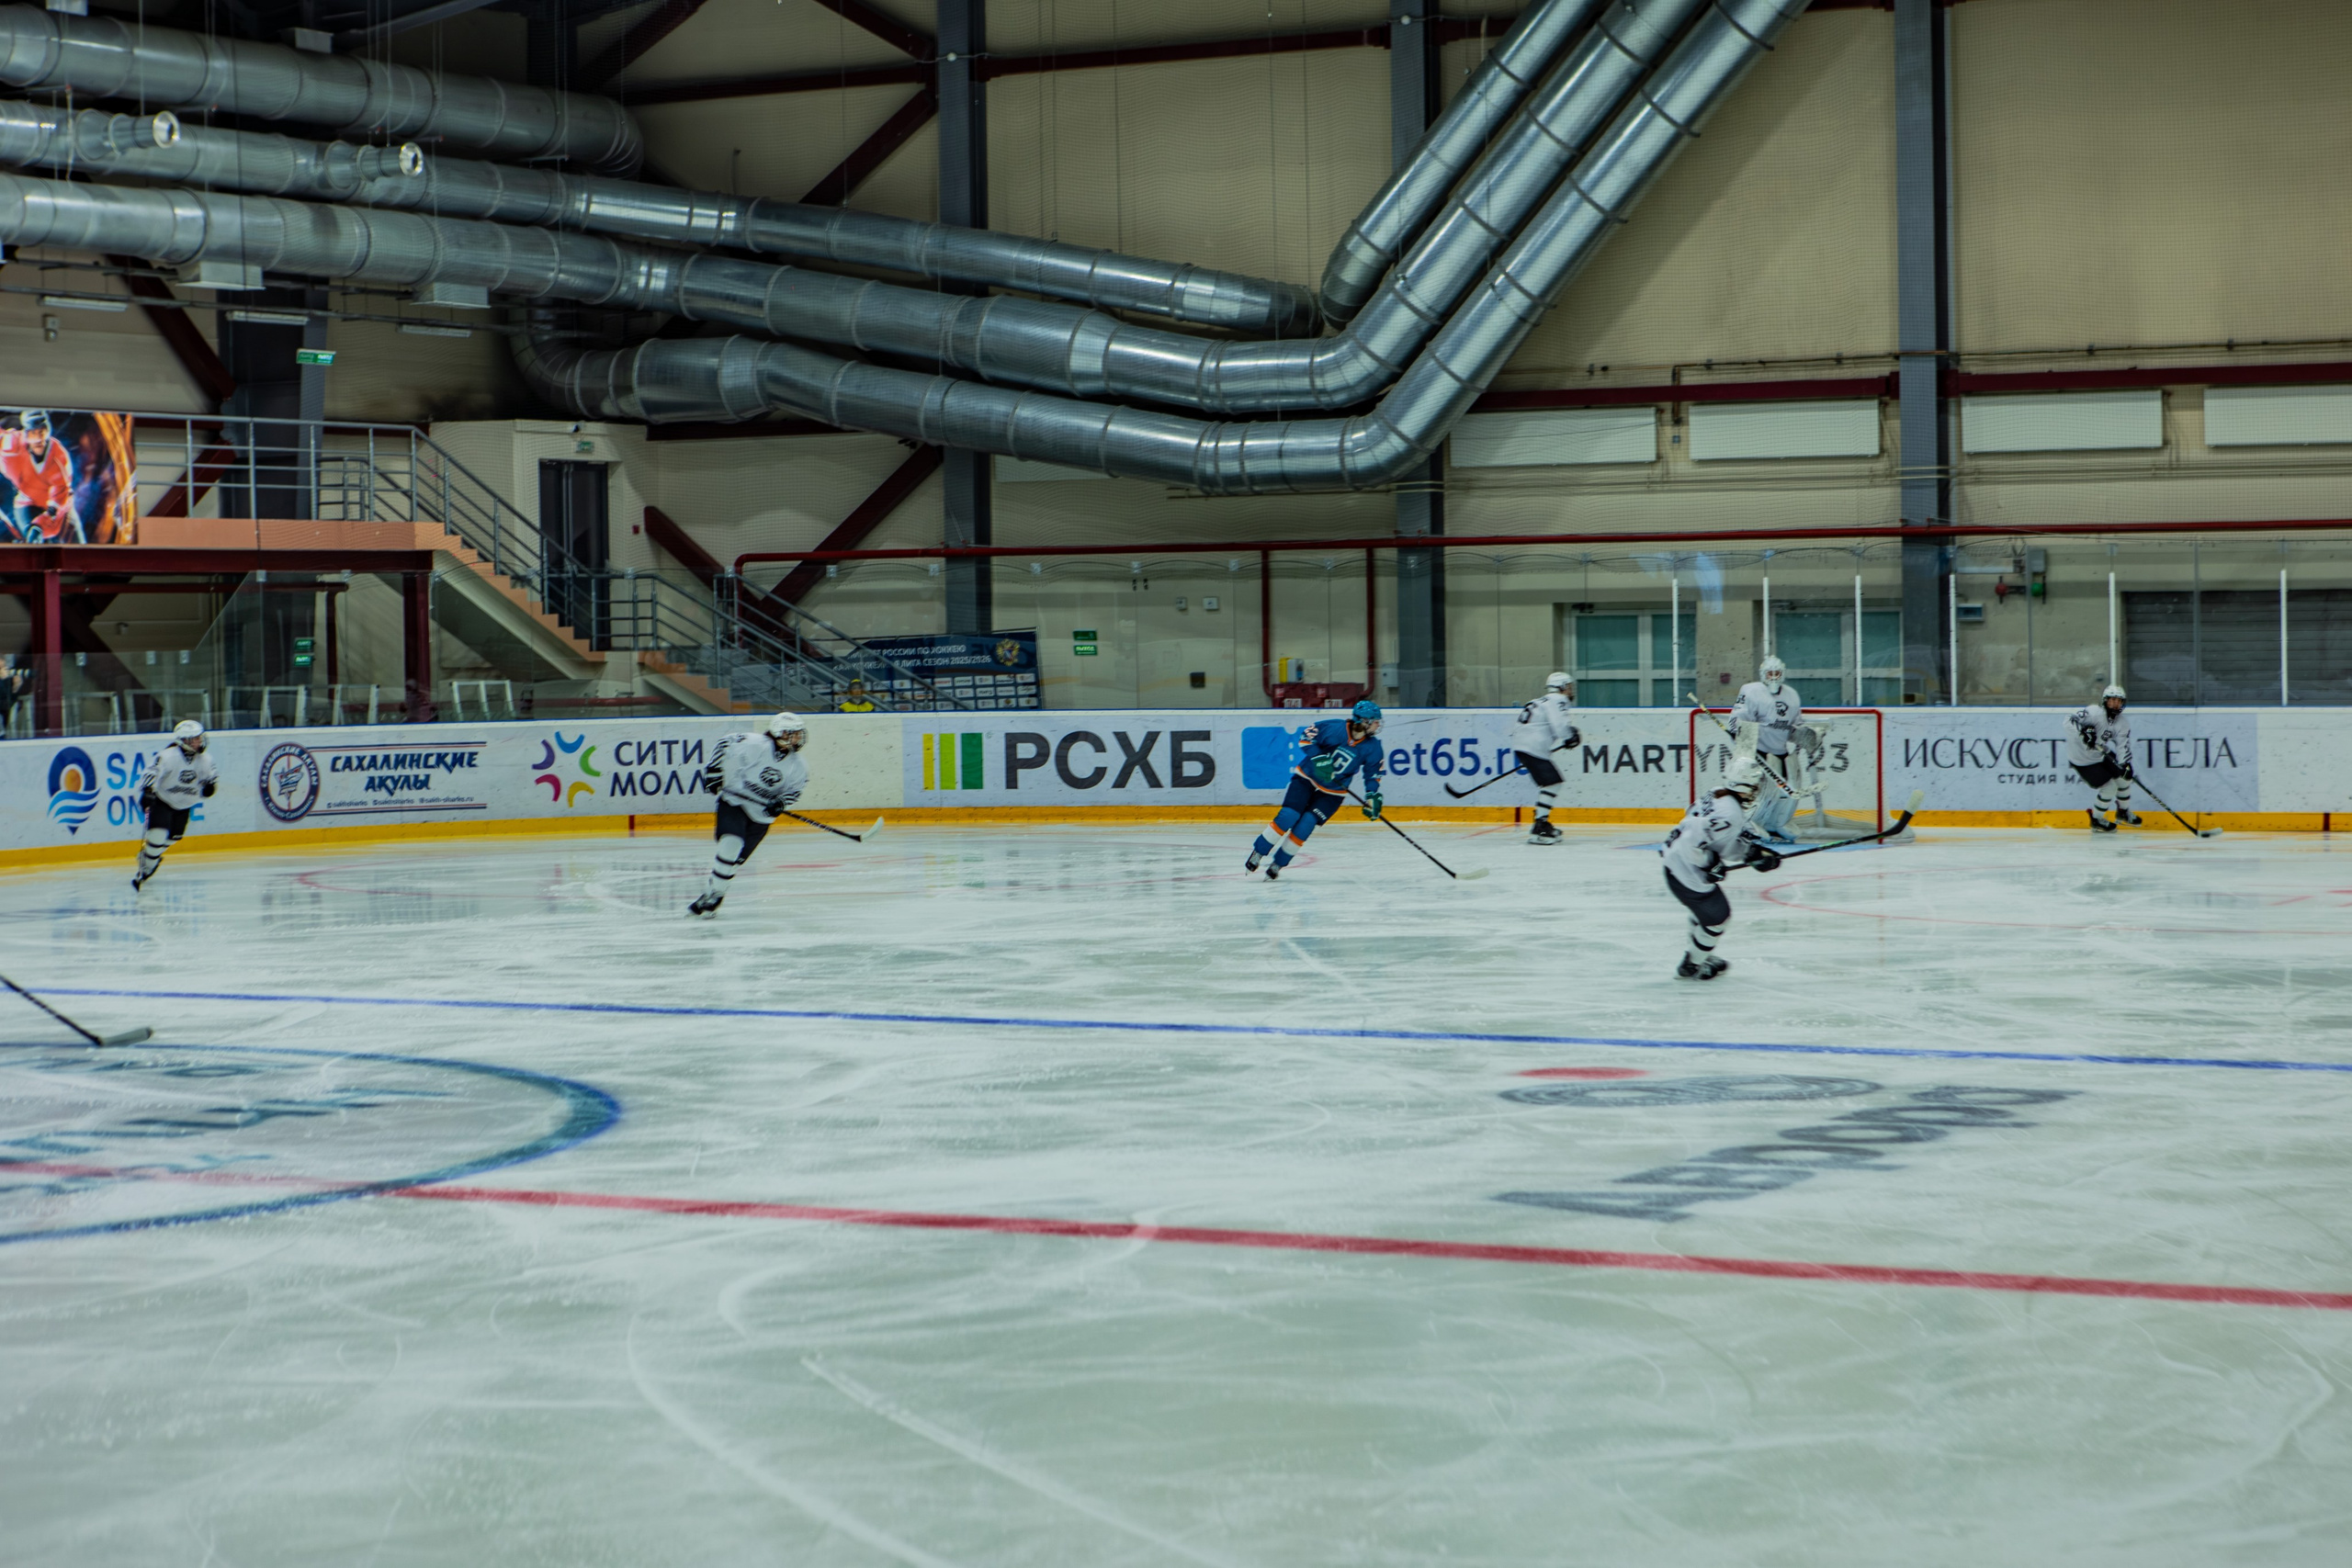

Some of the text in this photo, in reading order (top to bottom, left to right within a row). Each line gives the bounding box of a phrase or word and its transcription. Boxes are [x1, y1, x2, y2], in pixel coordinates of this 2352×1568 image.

[882, 648, 917, 657] РОССИИ
[922, 657, 949, 666] СЕЗОН
[330, 751, 479, 774] САХАЛИНСКИЕ
[614, 739, 703, 766] СИТИ
[1004, 729, 1216, 790] РСХБ
[1379, 738, 1529, 776] et65.r
[1583, 743, 1736, 773] MARTYN
[1904, 737, 2237, 769] ИСКУССТ ТЕЛА
[364, 773, 431, 796] АКУЛЫ
[1998, 773, 2057, 785] СТУДИЯ
